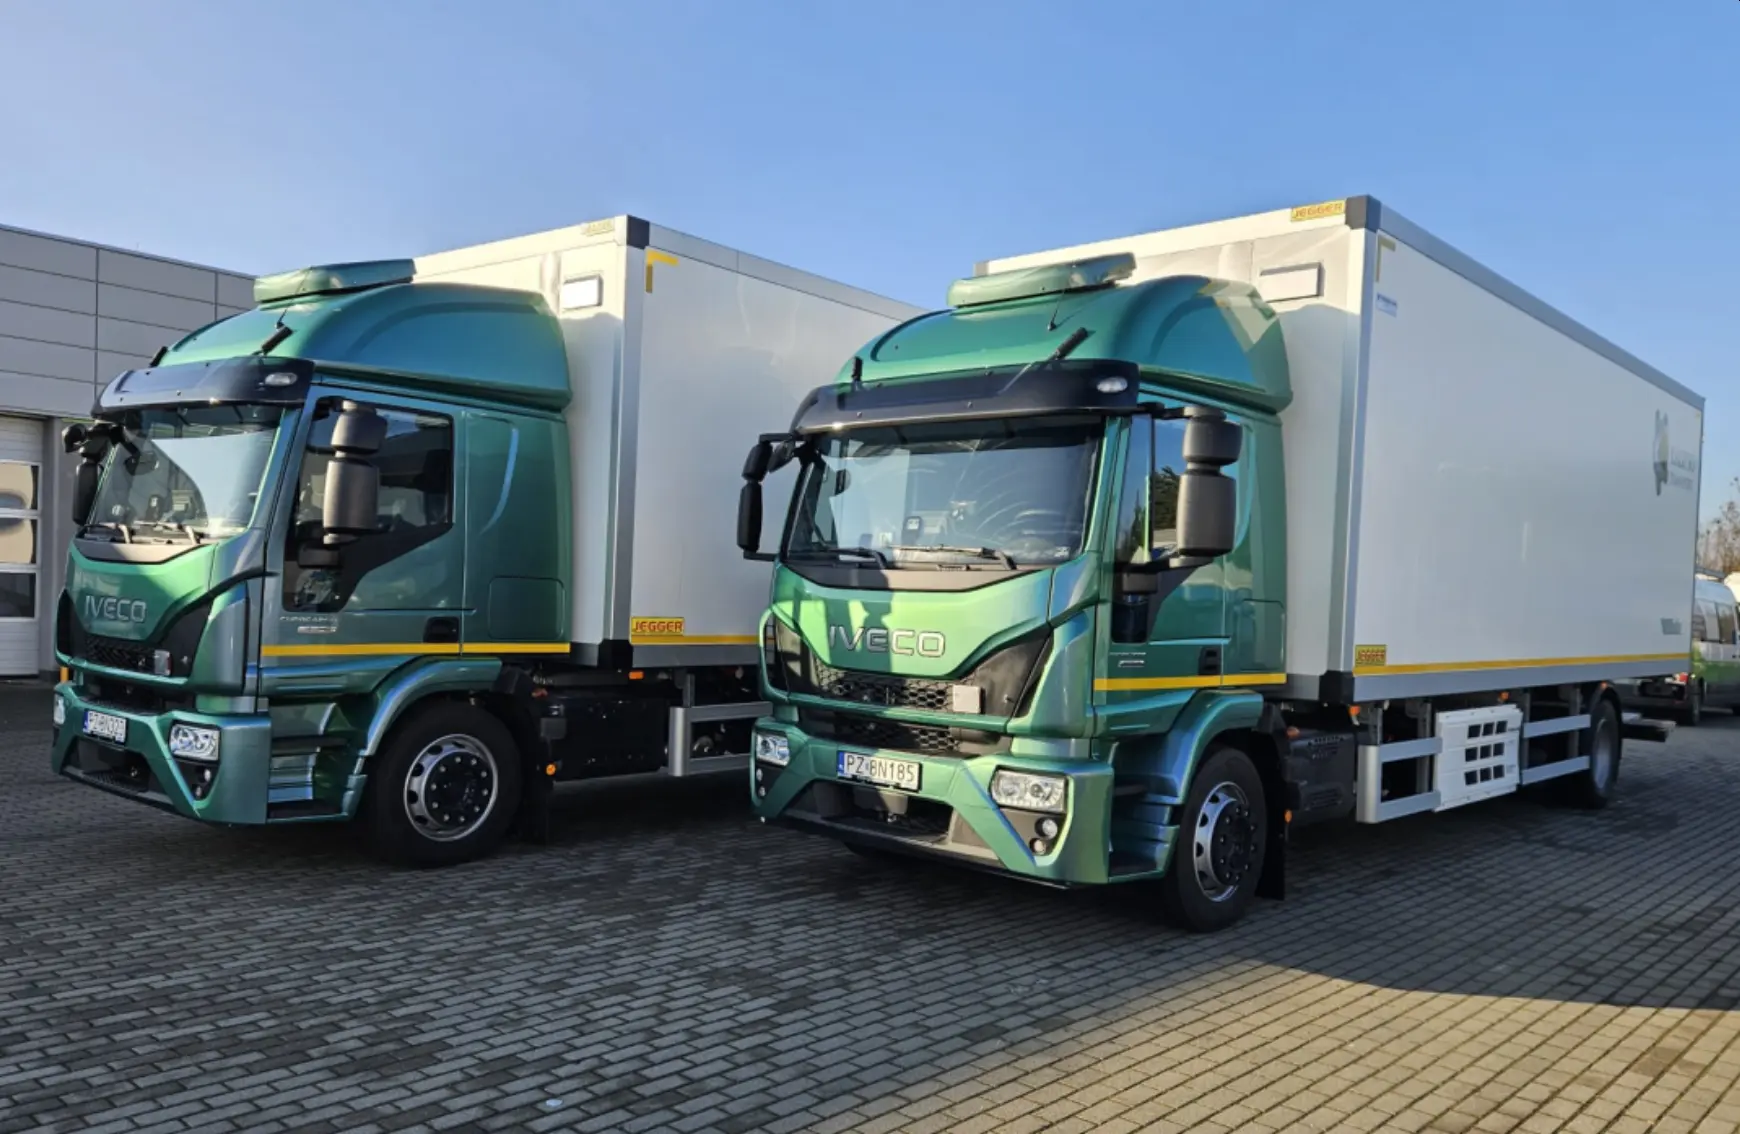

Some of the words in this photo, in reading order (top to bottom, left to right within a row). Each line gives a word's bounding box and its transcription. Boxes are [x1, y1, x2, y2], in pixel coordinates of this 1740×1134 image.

[84, 595, 146, 622] IVECO
[633, 621, 683, 632] JEGGER
[829, 625, 946, 658] IVECO
[847, 755, 865, 774] PZ
